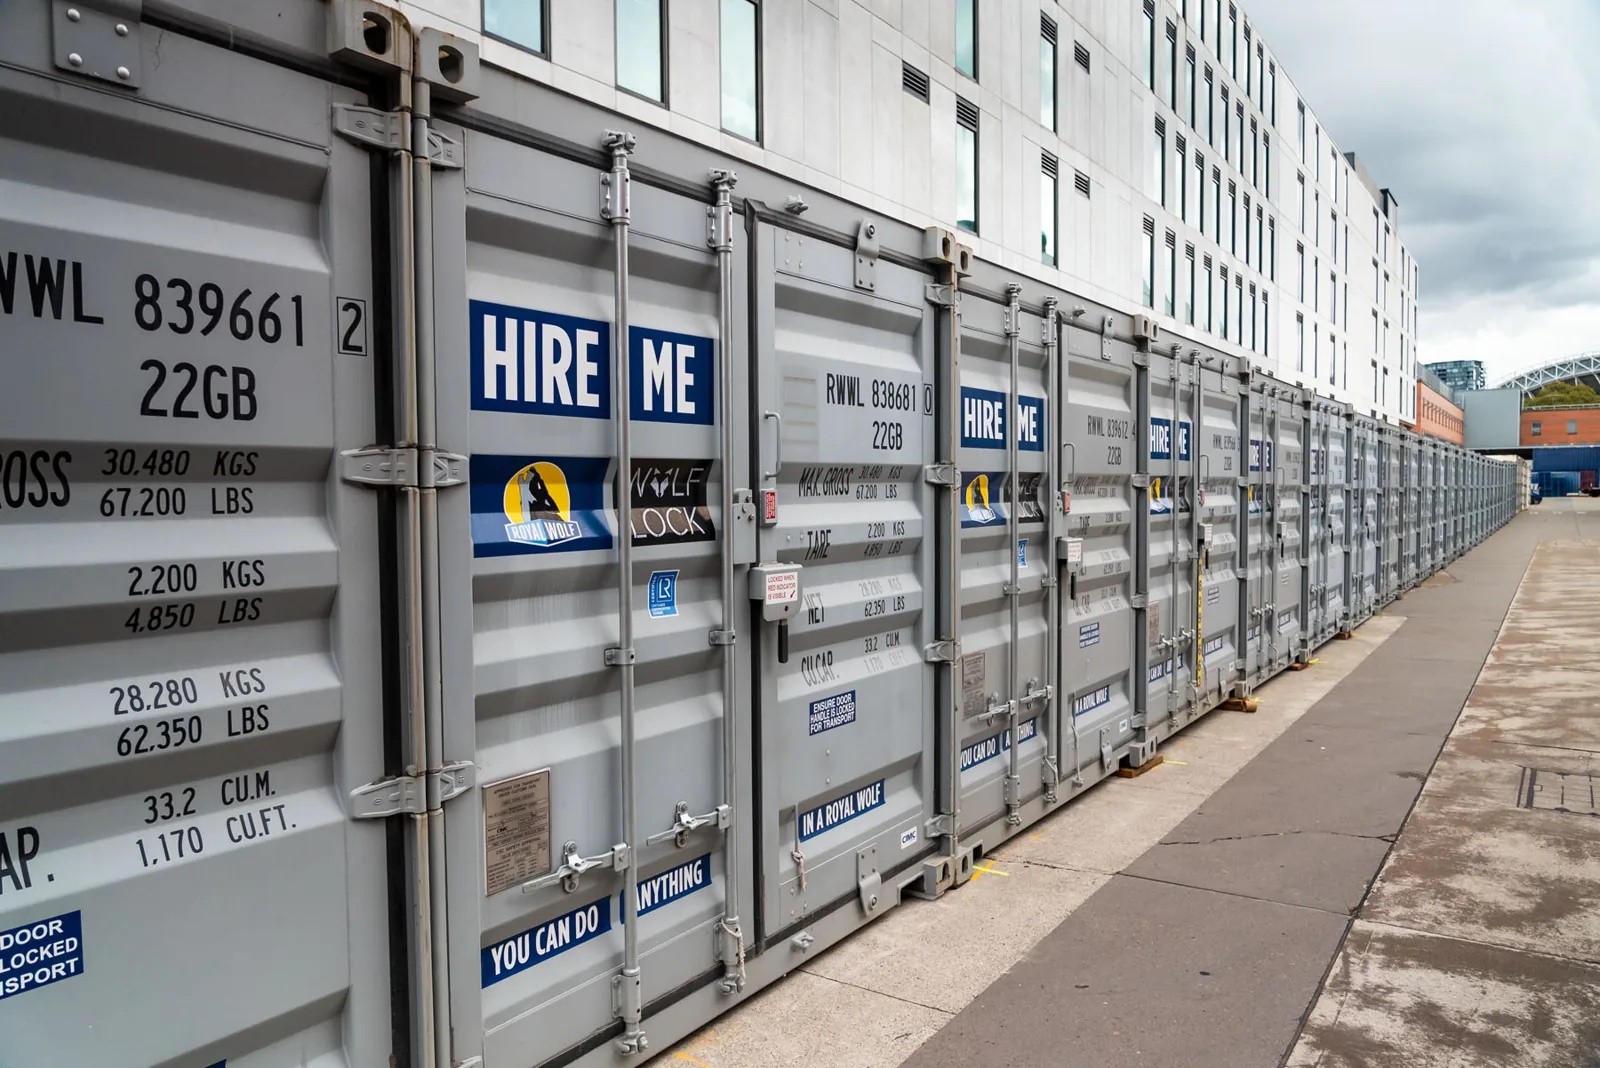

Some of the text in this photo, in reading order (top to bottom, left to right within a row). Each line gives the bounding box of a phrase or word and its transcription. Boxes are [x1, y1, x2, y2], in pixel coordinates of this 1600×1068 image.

[135, 274, 303, 346] 839661
[342, 302, 363, 352] 2
[484, 314, 696, 414] HIRE ME
[140, 359, 257, 421] 22GB
[827, 373, 864, 407] RWWL
[872, 379, 916, 412] 838681
[964, 397, 1037, 442] HIRE ME
[873, 420, 903, 451] 22GB
[1150, 424, 1169, 453] HIRE
[213, 451, 259, 476] KGS
[888, 466, 903, 480] KGS
[0, 450, 72, 508] OSS
[630, 467, 704, 497] WLF
[823, 467, 854, 496] GROSS
[885, 484, 898, 498] LBS
[211, 487, 253, 514] LBS
[511, 521, 575, 541] ROYAL WOLF
[631, 506, 706, 538] LOCK
[893, 521, 905, 536] KGS
[805, 528, 831, 560] TARE
[888, 540, 903, 555] LBS
[222, 560, 265, 589] KGS
[768, 575, 783, 583] LOCKED
[218, 597, 263, 624] LBS
[894, 595, 905, 612] LBS
[219, 668, 266, 698] KGS
[810, 701, 855, 724] HANDLE IS LOCKED
[814, 693, 852, 714] ENSURE DOOR
[227, 705, 269, 737] LBS
[811, 711, 854, 734] FOR TRANSPORT
[973, 741, 986, 762] CAN
[987, 737, 996, 757] DO
[144, 770, 276, 824] 33.2 CU.M.
[803, 782, 881, 837] IN A ROYAL WOLF
[0, 919, 64, 951] DOOR
[491, 905, 599, 976] YOU CAN DO
[0, 936, 78, 974] LOCKED
